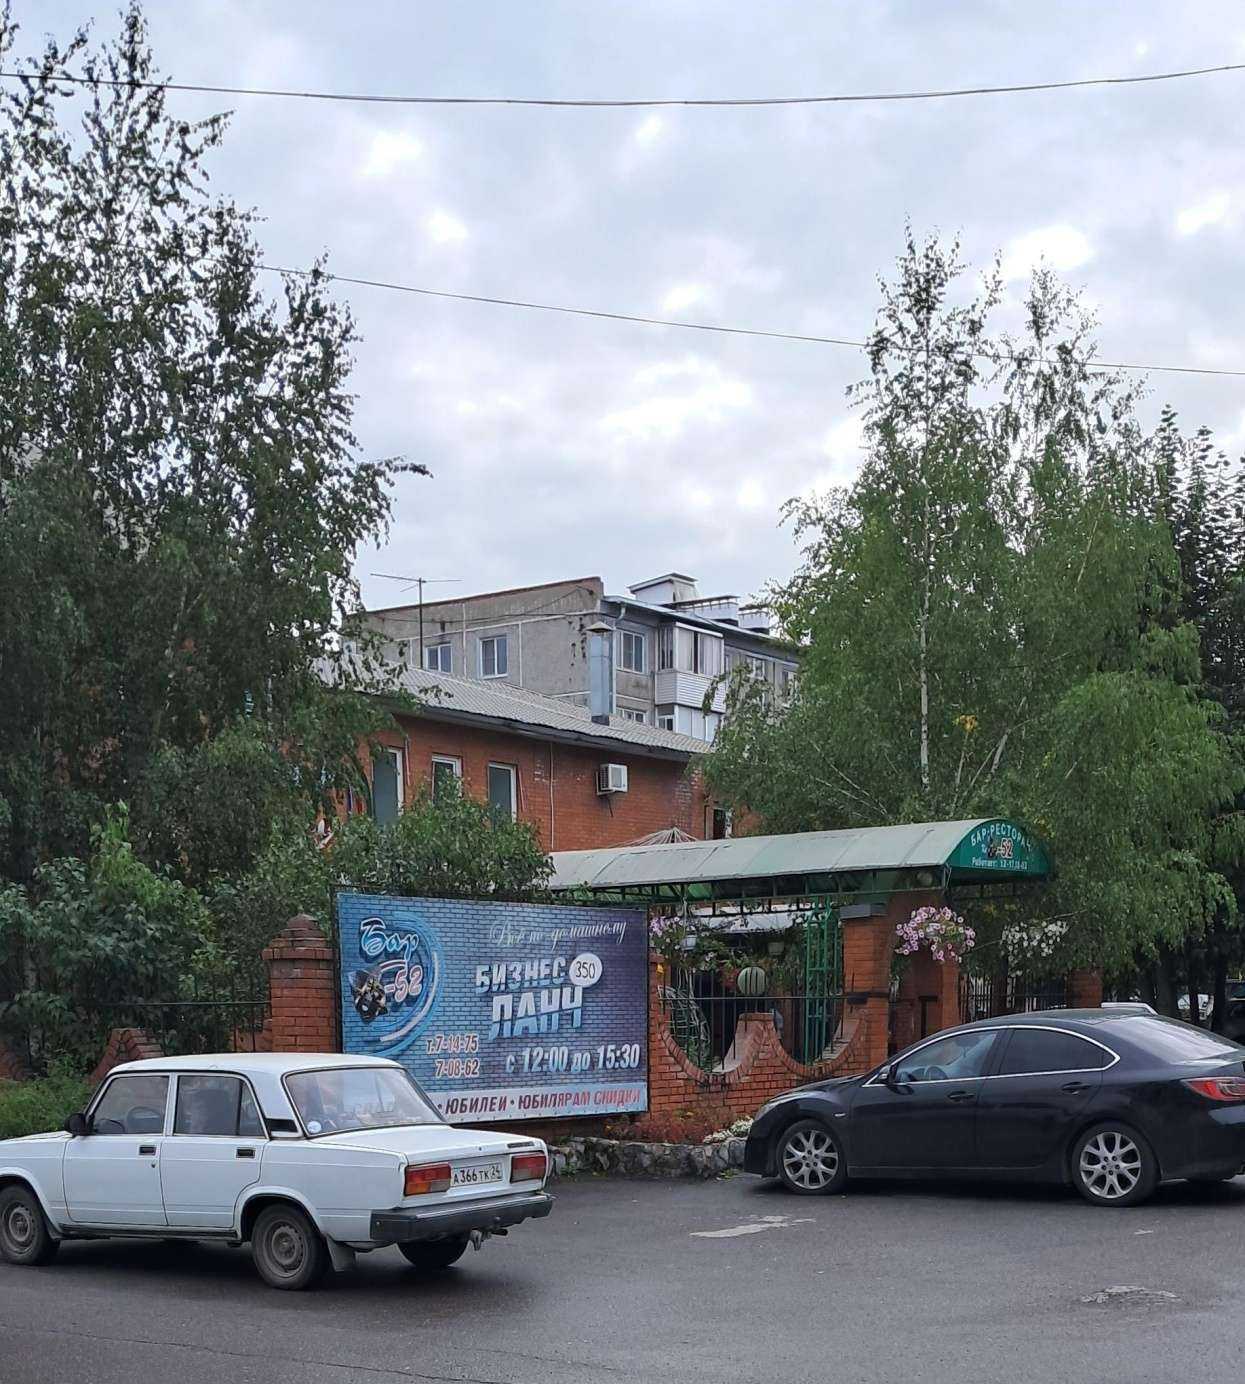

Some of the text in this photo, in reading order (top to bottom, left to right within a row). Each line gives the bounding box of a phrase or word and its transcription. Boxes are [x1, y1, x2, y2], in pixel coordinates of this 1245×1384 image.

[360, 917, 420, 967] Бар
[475, 956, 567, 994] БИЗНЕС
[575, 960, 596, 980] 350
[488, 985, 583, 1041] ЛАНЧ
[435, 1057, 480, 1079] 7-08-62
[521, 1046, 569, 1074] 12:00
[572, 1056, 591, 1074] до
[596, 1043, 640, 1069] 15:30
[518, 1090, 591, 1110] ЮБИЛЯРАМ
[593, 1088, 641, 1107] СКИДКИ
